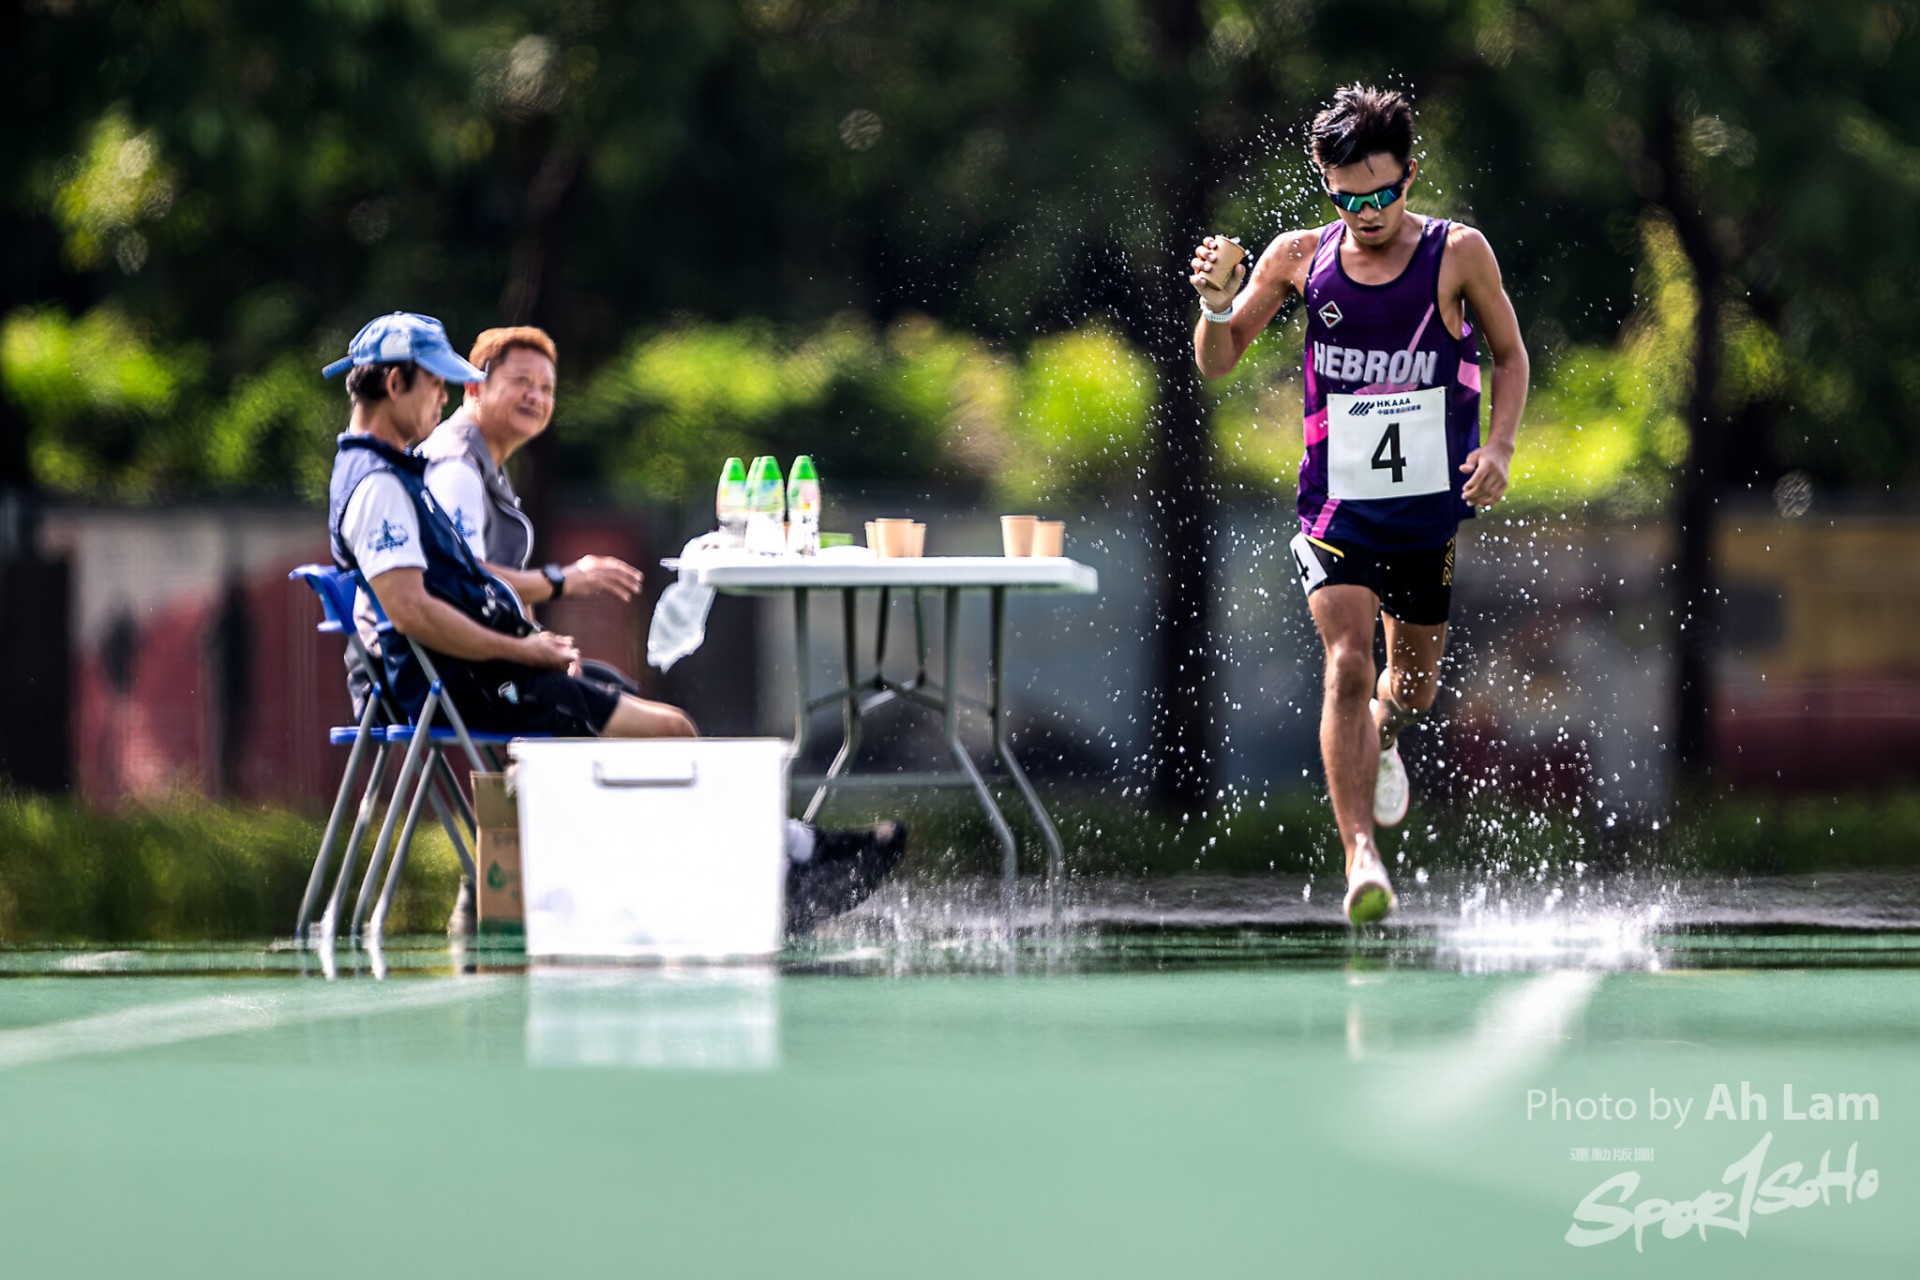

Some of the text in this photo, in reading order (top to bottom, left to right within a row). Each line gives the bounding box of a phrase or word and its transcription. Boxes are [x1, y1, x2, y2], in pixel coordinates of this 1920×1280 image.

[1313, 340, 1438, 385] HEBRON
[1376, 397, 1411, 408] HKAAA
[1371, 422, 1407, 483] 4
